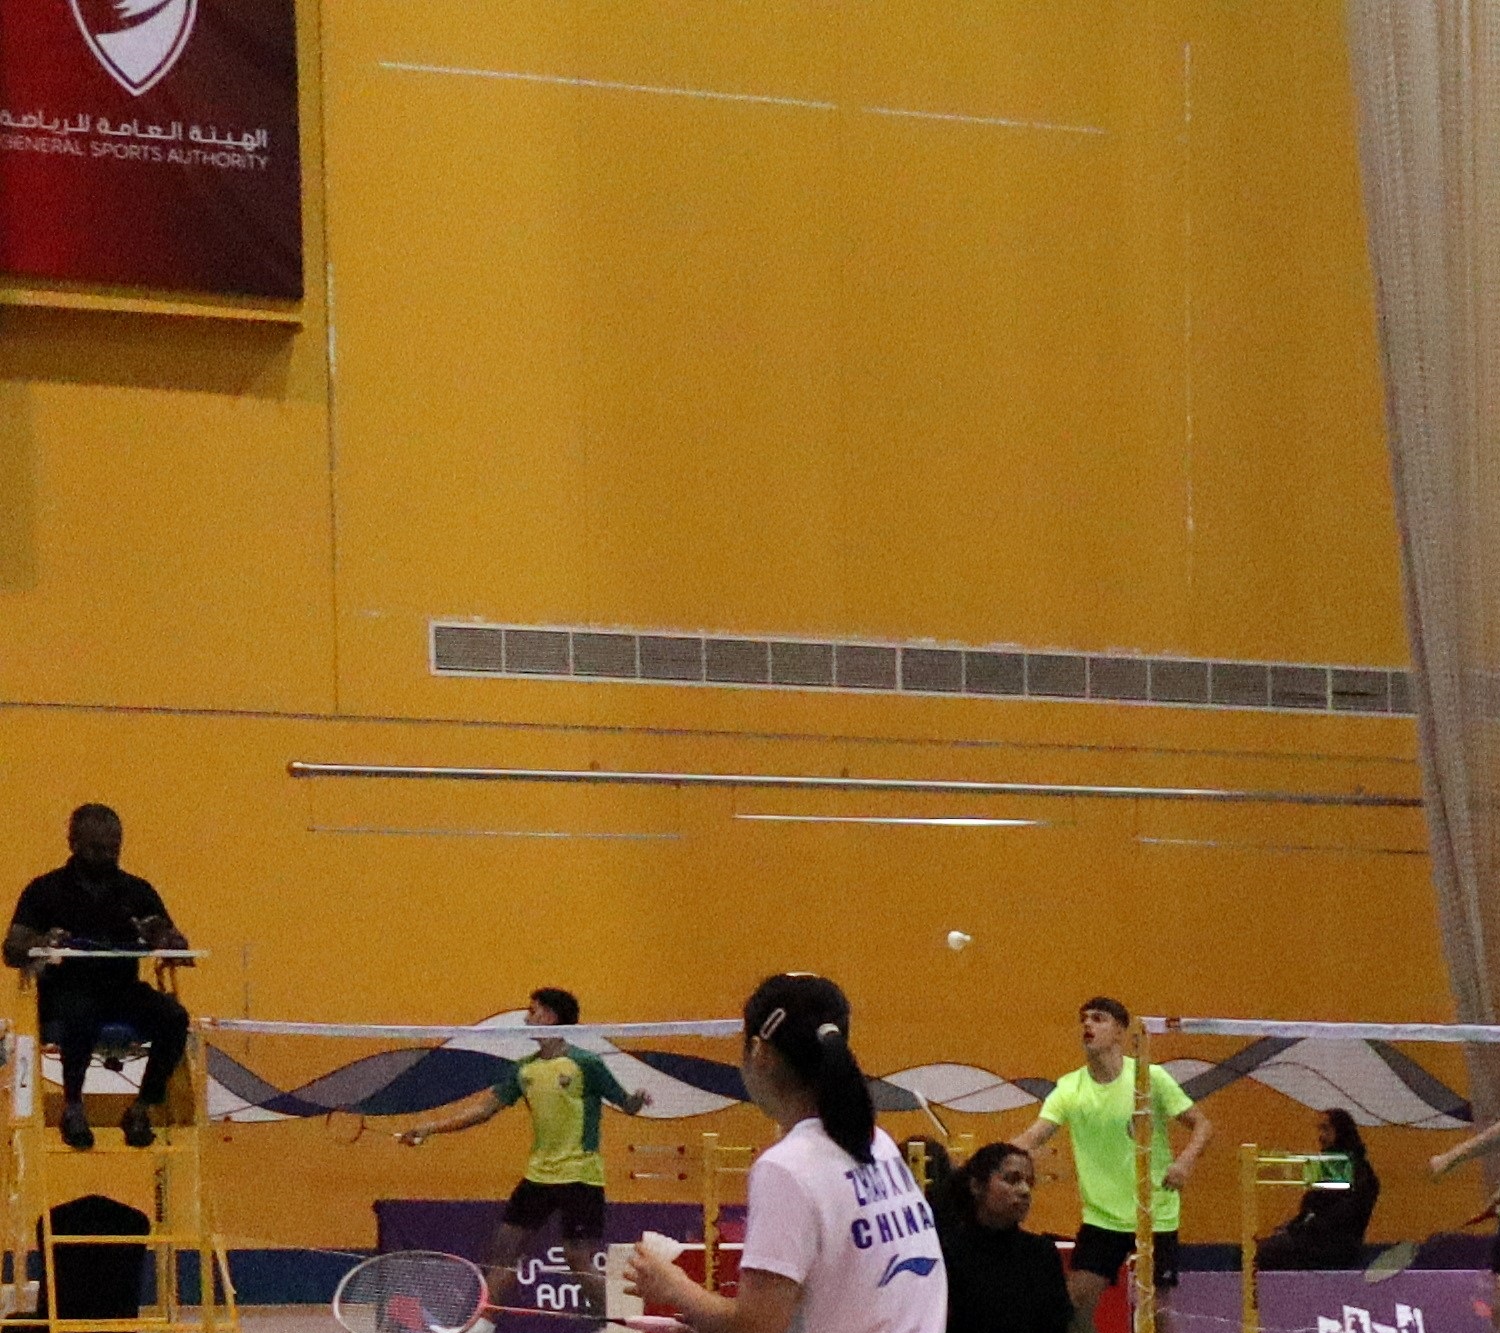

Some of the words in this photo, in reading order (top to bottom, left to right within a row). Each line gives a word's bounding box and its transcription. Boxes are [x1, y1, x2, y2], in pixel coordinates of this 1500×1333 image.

[90, 142, 162, 163] SPORTS
[167, 148, 268, 171] AUTHORITY
[850, 1201, 935, 1250] CHINA
